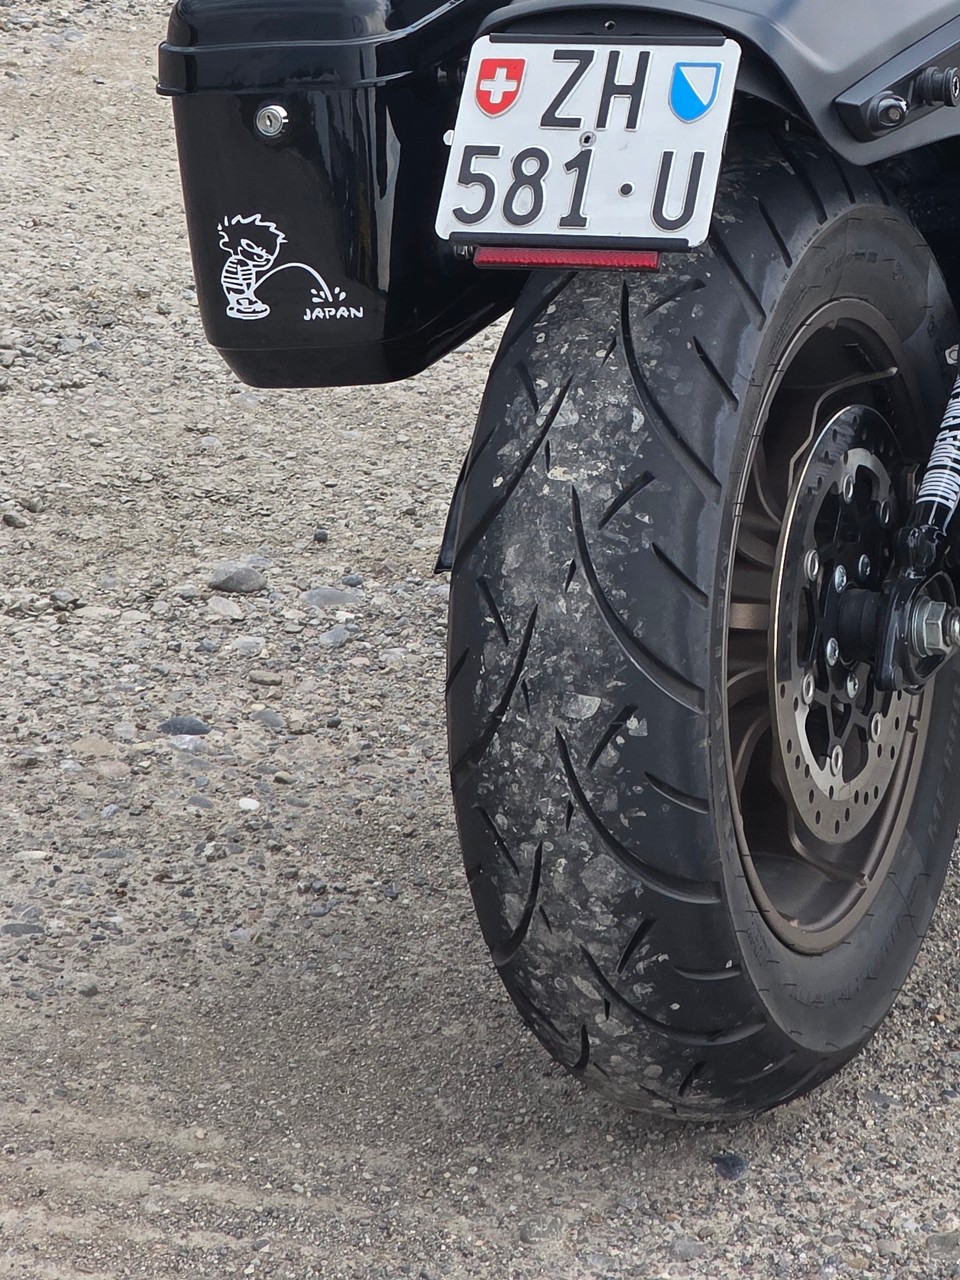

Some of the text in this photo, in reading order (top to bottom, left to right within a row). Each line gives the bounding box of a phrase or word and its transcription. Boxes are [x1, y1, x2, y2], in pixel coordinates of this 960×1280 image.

[540, 49, 650, 130] ZH
[652, 151, 706, 231] U
[303, 306, 364, 321] JAPAN
